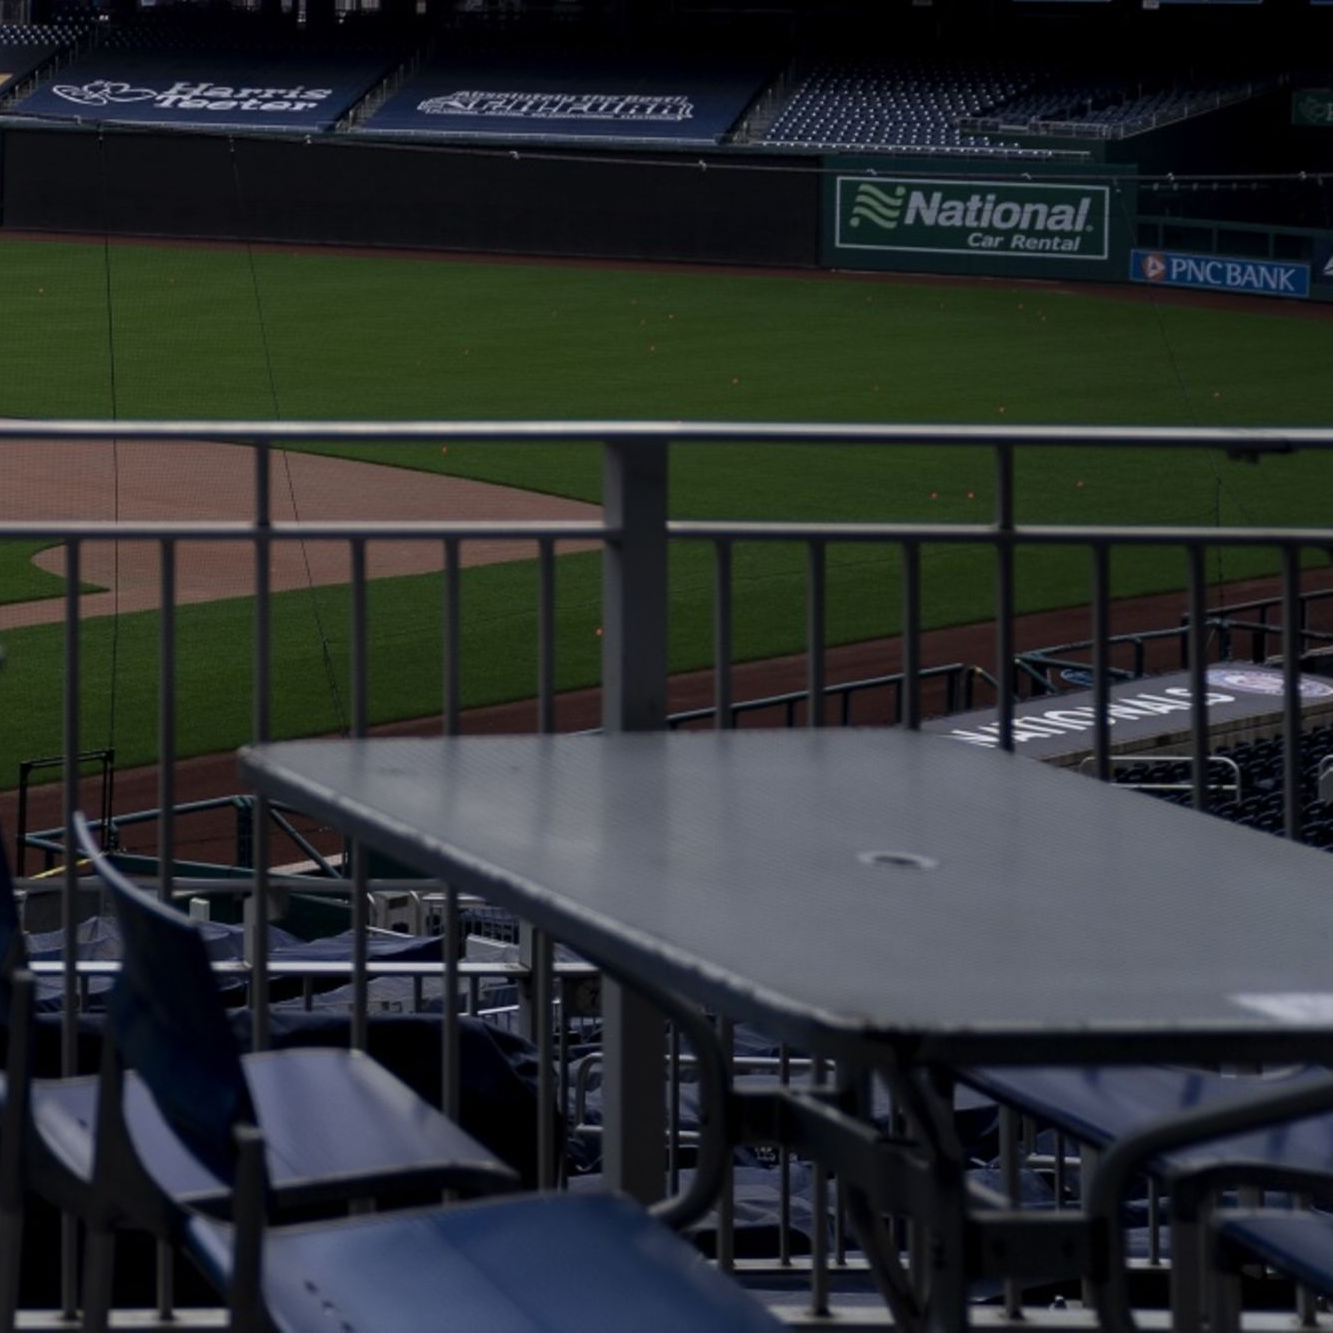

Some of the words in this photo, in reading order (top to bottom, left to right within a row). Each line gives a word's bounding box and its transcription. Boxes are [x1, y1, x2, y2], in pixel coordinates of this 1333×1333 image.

[162, 81, 333, 100] Harris
[153, 94, 318, 111] Teeter
[967, 232, 1005, 248] Car
[1010, 233, 1081, 253] Rental
